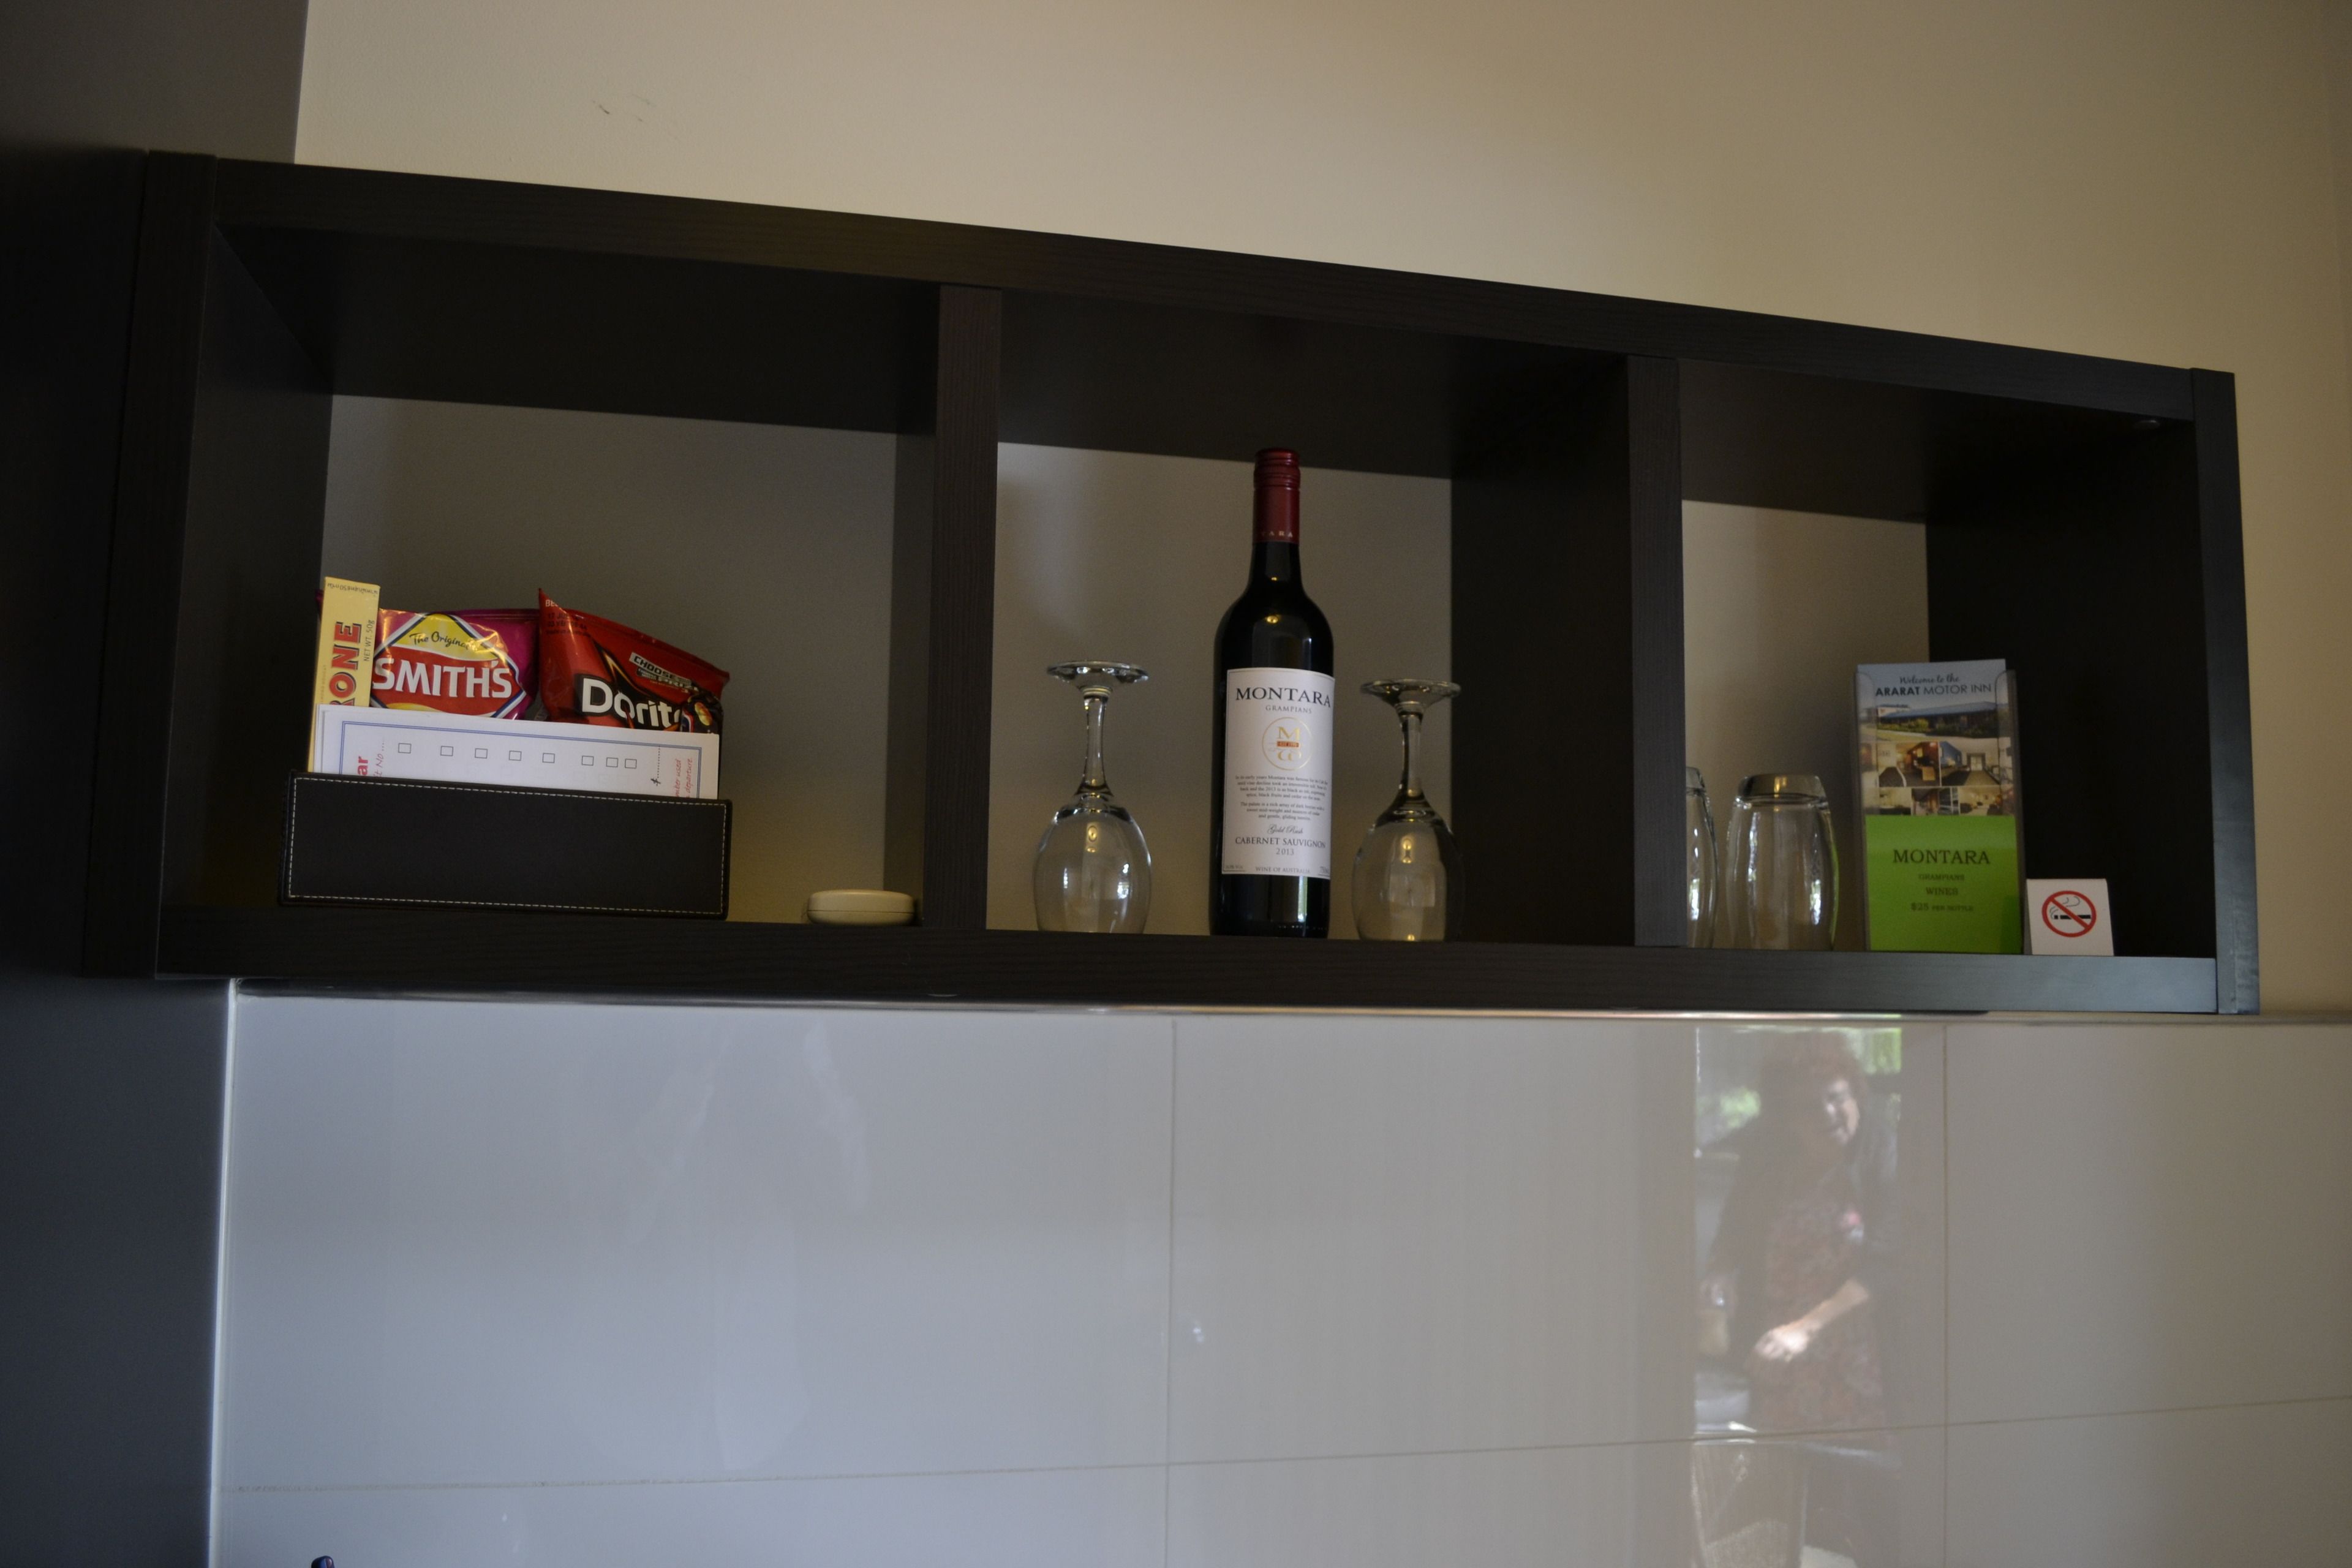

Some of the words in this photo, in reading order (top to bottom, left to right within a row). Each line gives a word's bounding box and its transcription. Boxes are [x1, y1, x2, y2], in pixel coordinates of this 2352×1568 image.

[366, 620, 375, 633] 50g
[409, 633, 429, 646] The
[431, 631, 473, 650] Origina
[372, 658, 512, 698] SMITH'S
[1900, 674, 1934, 684] Welcome
[1947, 673, 1959, 682] the
[1875, 686, 1921, 696] ARARAT
[1923, 685, 1967, 695] MOTOR
[1971, 684, 1991, 693] INN
[1236, 687, 1331, 708] MONTARA
[1265, 704, 1312, 714] GRAMPIANS
[1235, 837, 1281, 845] CABERNET
[1283, 838, 1326, 848] SAUVIGNON
[1893, 849, 1991, 864] MONTARA
[1926, 886, 1959, 895] WINES
[1911, 902, 1929, 911] $25
